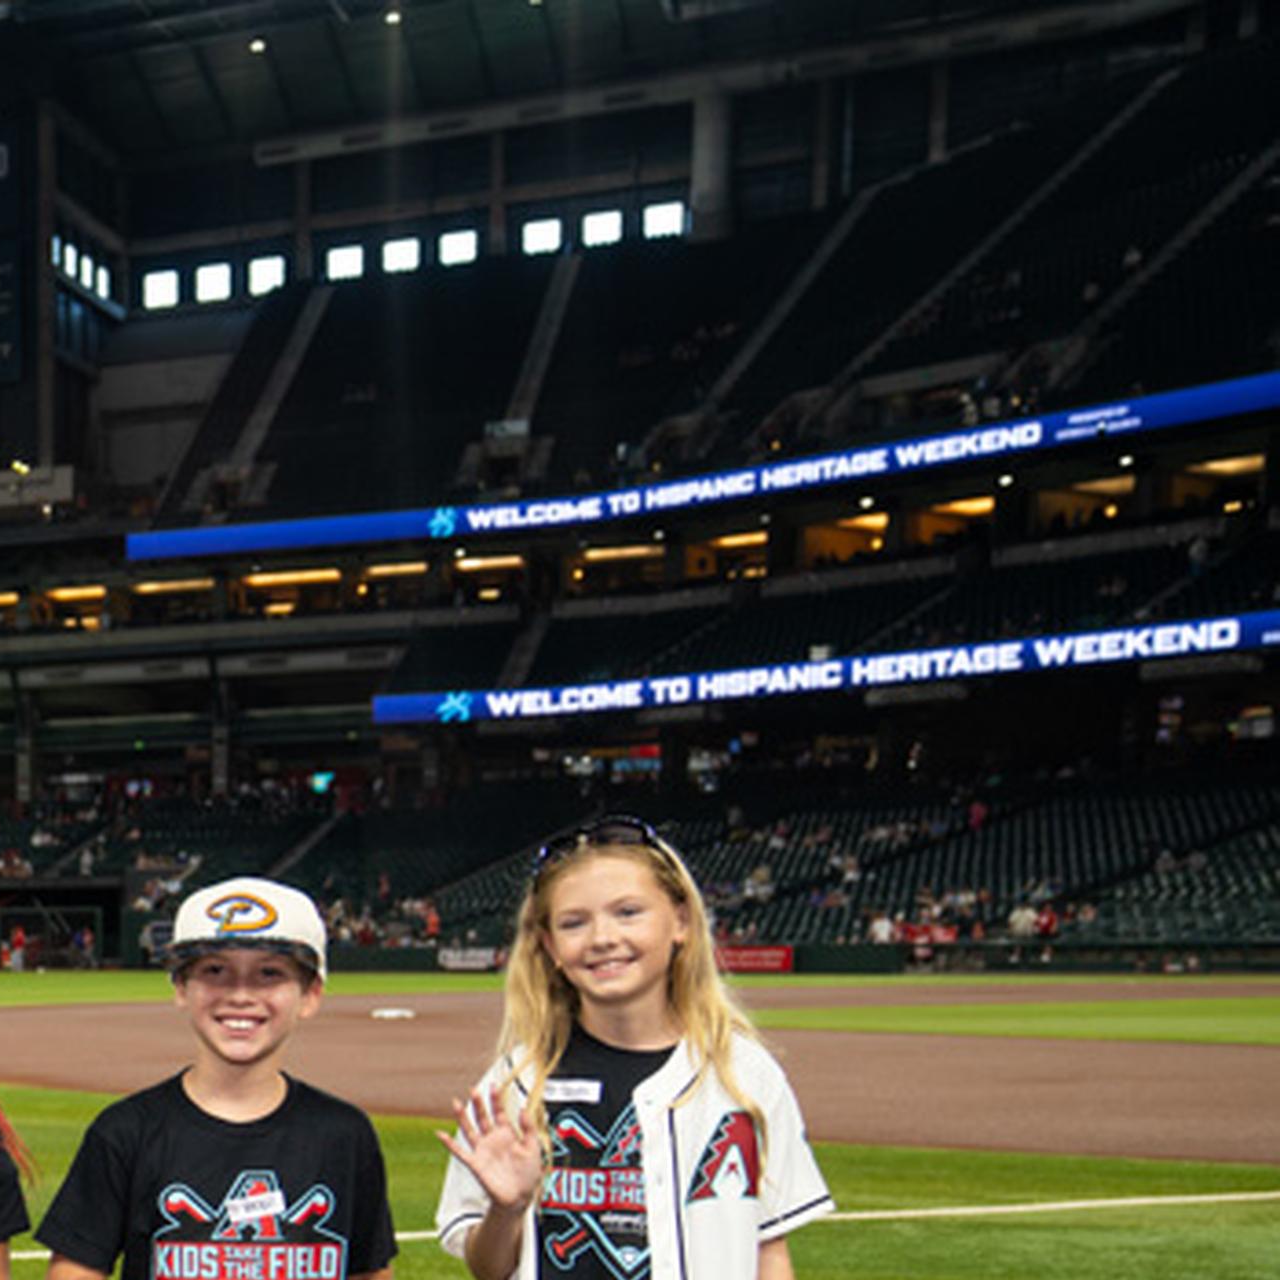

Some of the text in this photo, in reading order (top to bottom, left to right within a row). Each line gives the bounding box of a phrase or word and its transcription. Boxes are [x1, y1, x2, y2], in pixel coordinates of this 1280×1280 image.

[466, 498, 603, 531] WELCOME
[607, 494, 641, 516] TO
[645, 472, 756, 509] HISPANIC
[761, 449, 889, 490] HERITAGE
[894, 420, 1042, 468] WEEKEND
[486, 619, 1240, 717] WELCOME TO HISPANIC HERITAGE WEEKEND
[543, 1170, 605, 1206] KIDS
[157, 1244, 339, 1280] KIDS TAKE THE FIELD
